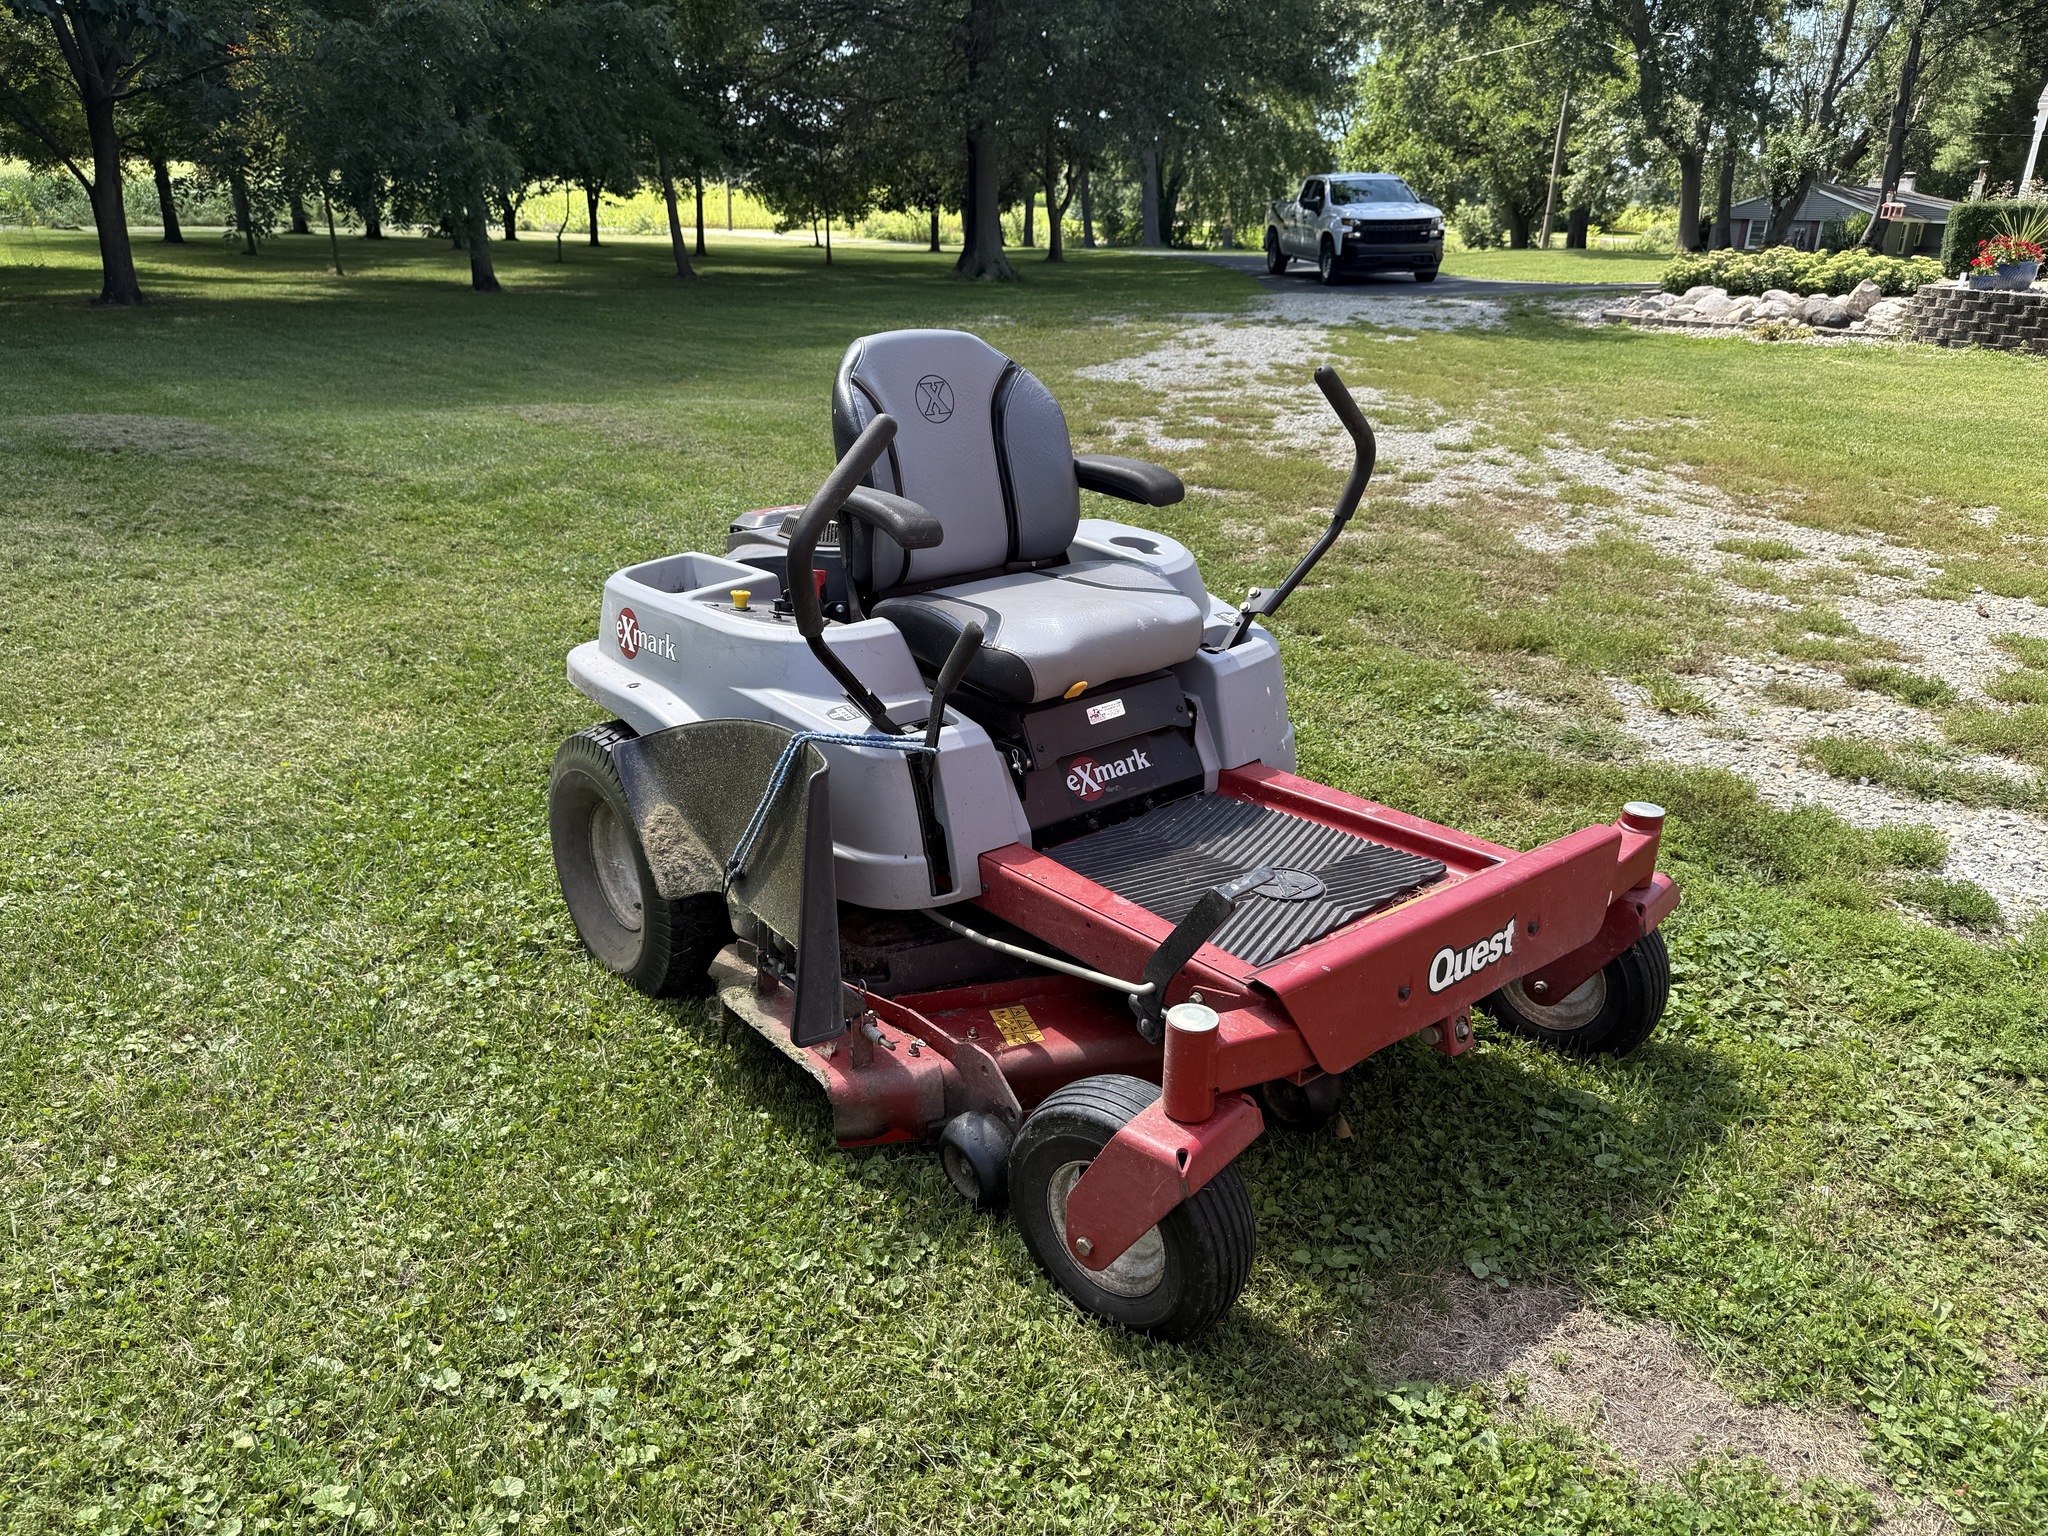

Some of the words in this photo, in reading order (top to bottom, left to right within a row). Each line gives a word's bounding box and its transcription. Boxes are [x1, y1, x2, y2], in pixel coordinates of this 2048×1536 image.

[919, 380, 952, 416] X
[616, 614, 677, 662] eXmark
[1066, 748, 1152, 797] eXmark
[1428, 916, 1516, 993] Quest
